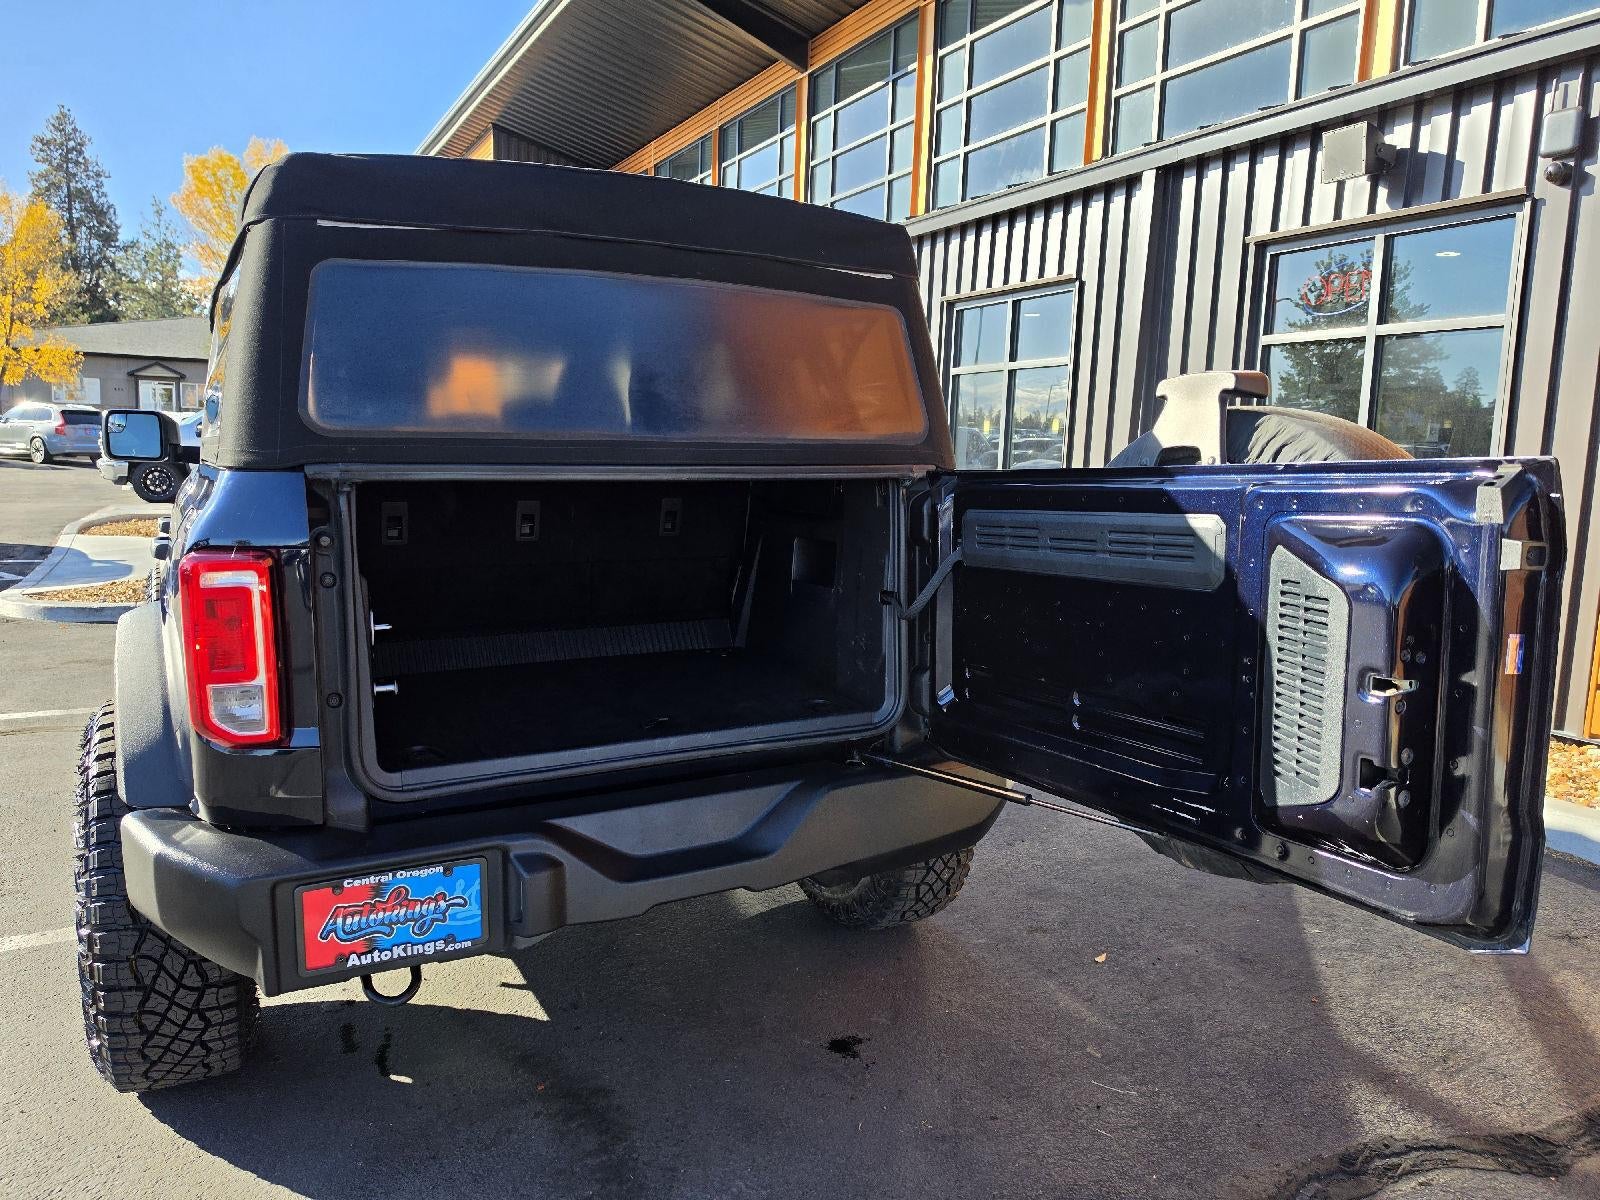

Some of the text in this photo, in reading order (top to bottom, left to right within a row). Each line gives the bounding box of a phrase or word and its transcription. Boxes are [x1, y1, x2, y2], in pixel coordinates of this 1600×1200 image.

[343, 864, 444, 889] Central Oregon
[346, 938, 472, 968] AutoKings.com
